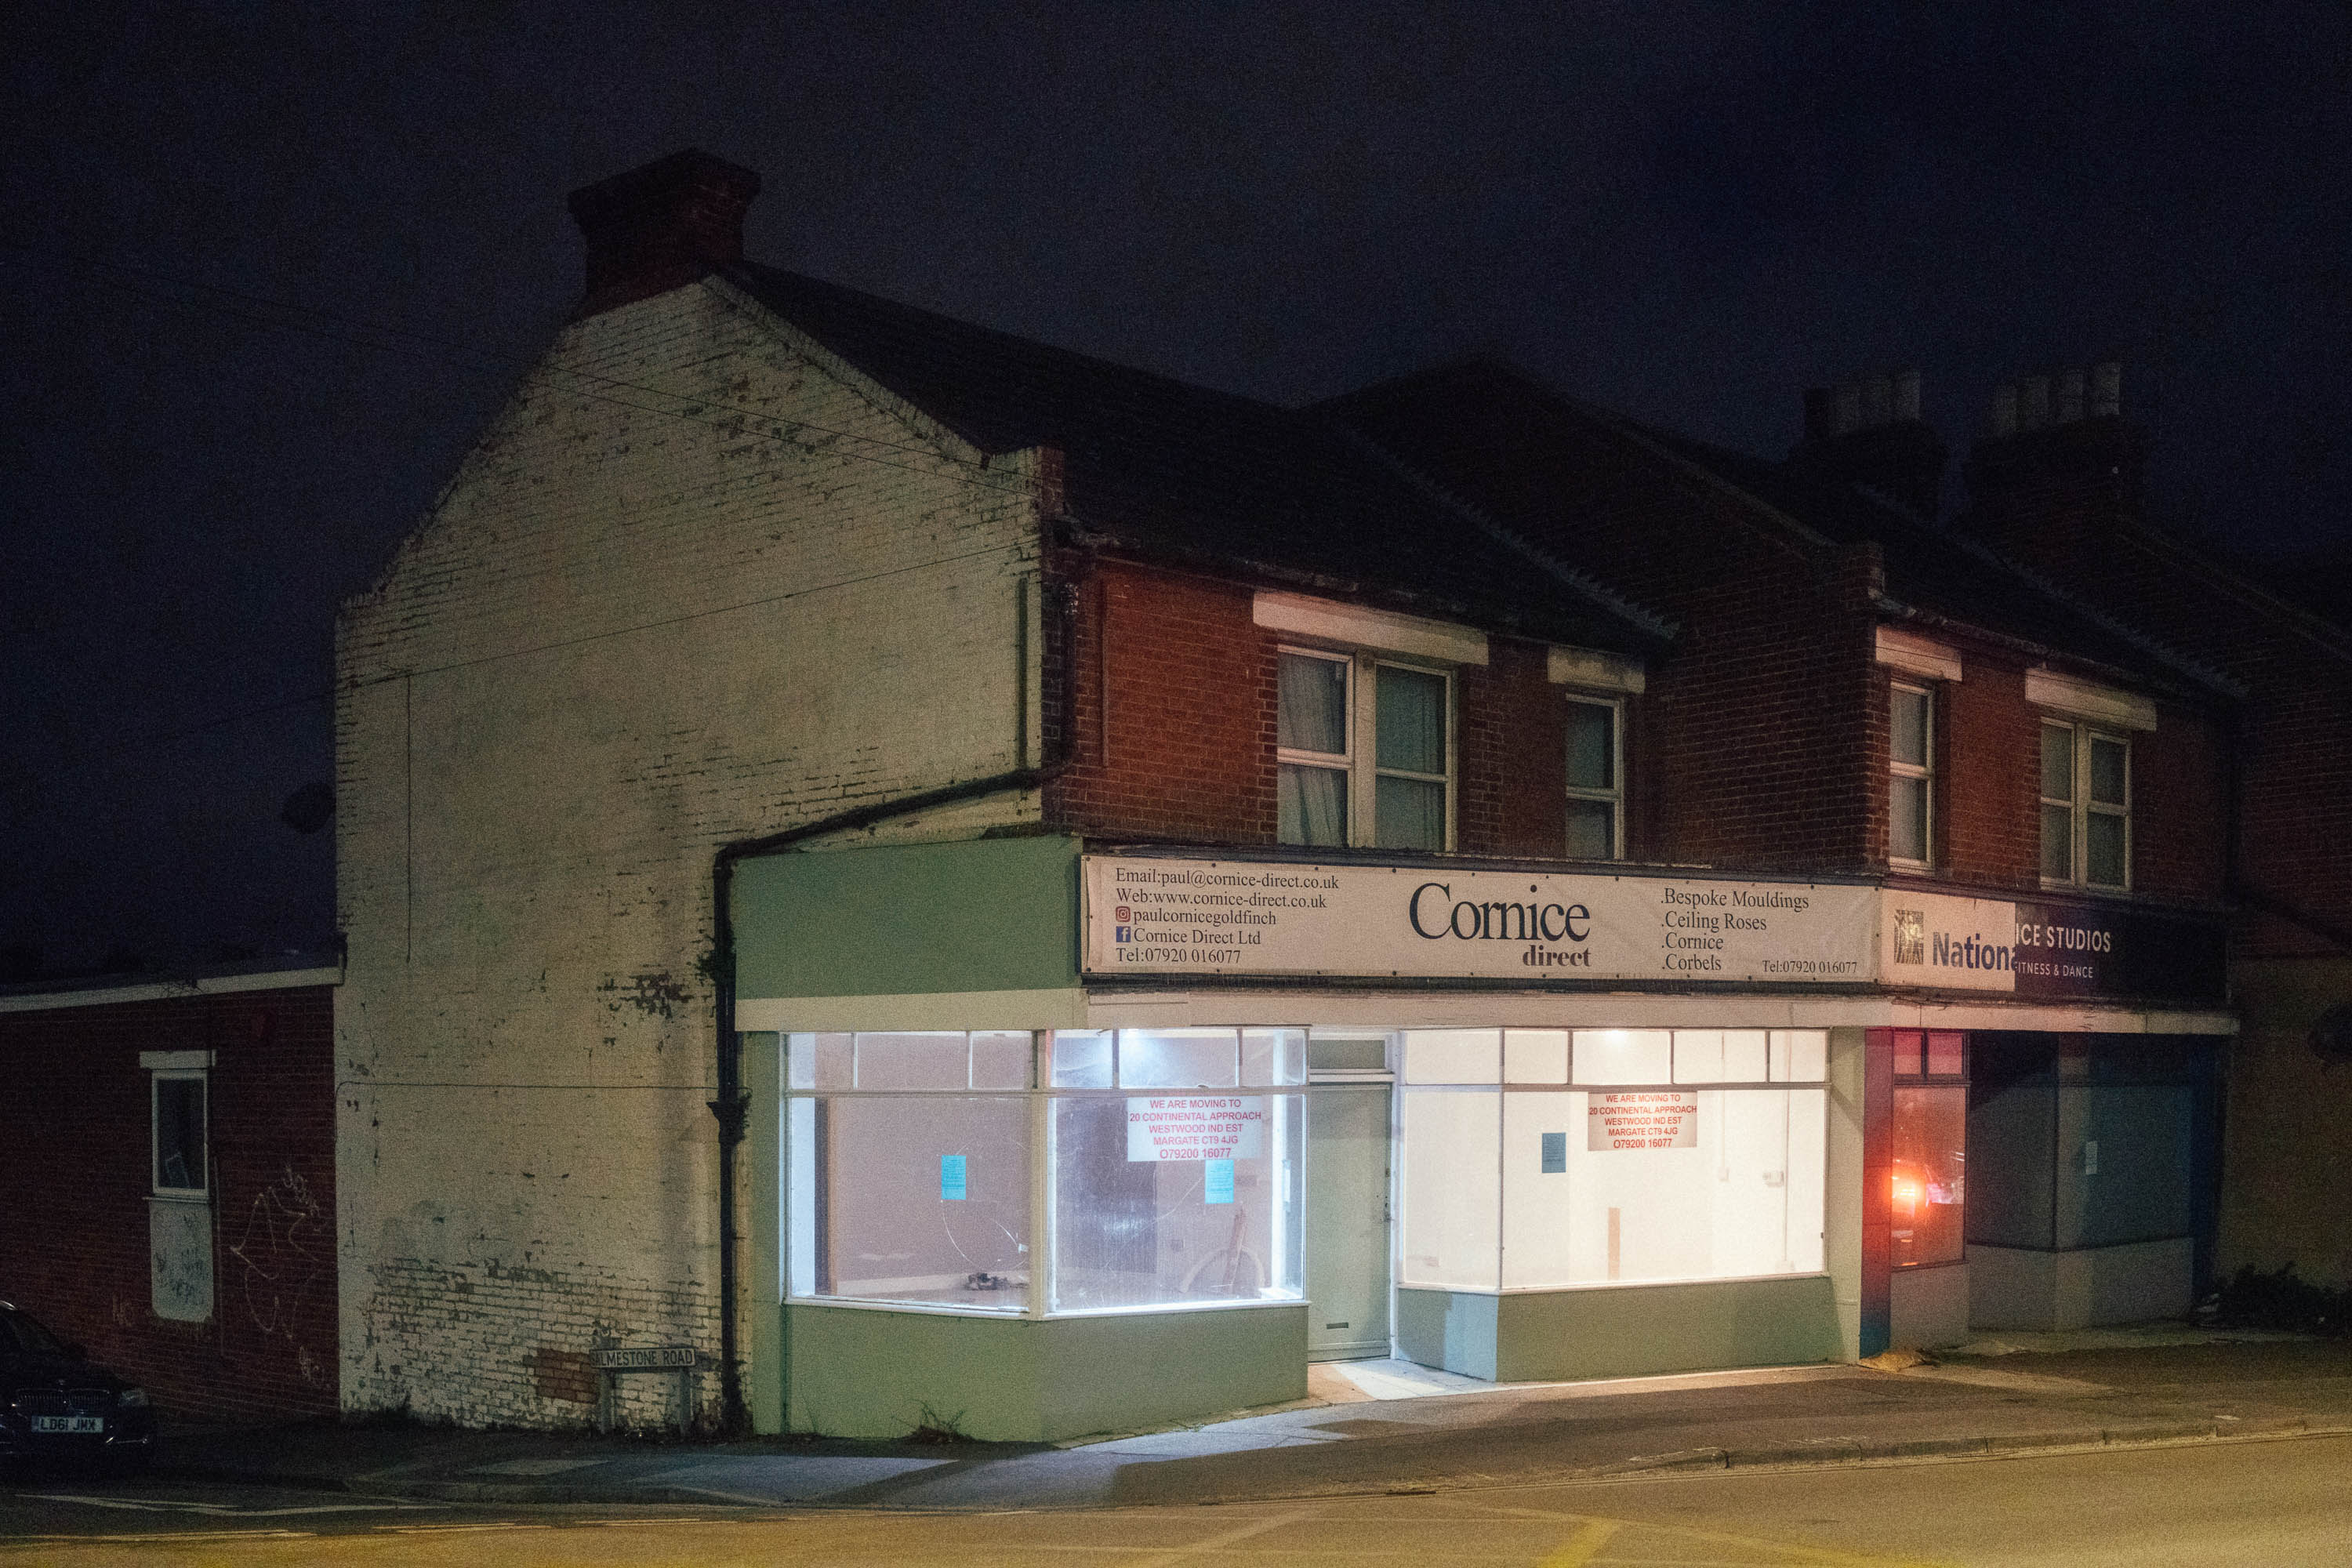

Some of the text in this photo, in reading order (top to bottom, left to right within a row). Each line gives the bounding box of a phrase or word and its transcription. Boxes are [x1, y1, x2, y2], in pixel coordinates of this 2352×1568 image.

[1116, 867, 1339, 889] Email:paul@cornice-direct.co.uk
[1116, 887, 1327, 908] Web:www.cornice-direct.co.uk
[1732, 891, 1809, 913] Mouldings
[1134, 908, 1277, 927] paulcornicegoldfinch
[1409, 882, 1591, 942] Cornice
[1724, 913, 1767, 931] Roses
[1134, 927, 1188, 943] Cornice
[1192, 929, 1235, 945] Direct
[1238, 931, 1261, 945] Ltd
[2046, 926, 2111, 953] STUDIOS
[1116, 948, 1241, 964] Tel:07920 016077
[1523, 944, 1592, 967] direct
[1762, 960, 1857, 974] Tel:07920 016077
[2053, 964, 2060, 977] &
[2063, 965, 2093, 978] DANCE
[1150, 1099, 1241, 1109] WE ARE MOVING TO
[1599, 1106, 1653, 1115] CONTINENTAL
[1654, 1105, 1697, 1114] APPROACH
[1130, 1111, 1261, 1122] 20 CONTINENTAL APPROACH
[1149, 1123, 1243, 1134] WESTWOOD IND EST
[1154, 1135, 1238, 1145] MARGATE CT9 4JG
[1649, 1138, 1673, 1148] 16077
[1203, 1148, 1232, 1158] 16077
[663, 1349, 693, 1365] ROAD
[41, 1418, 69, 1431] LD61
